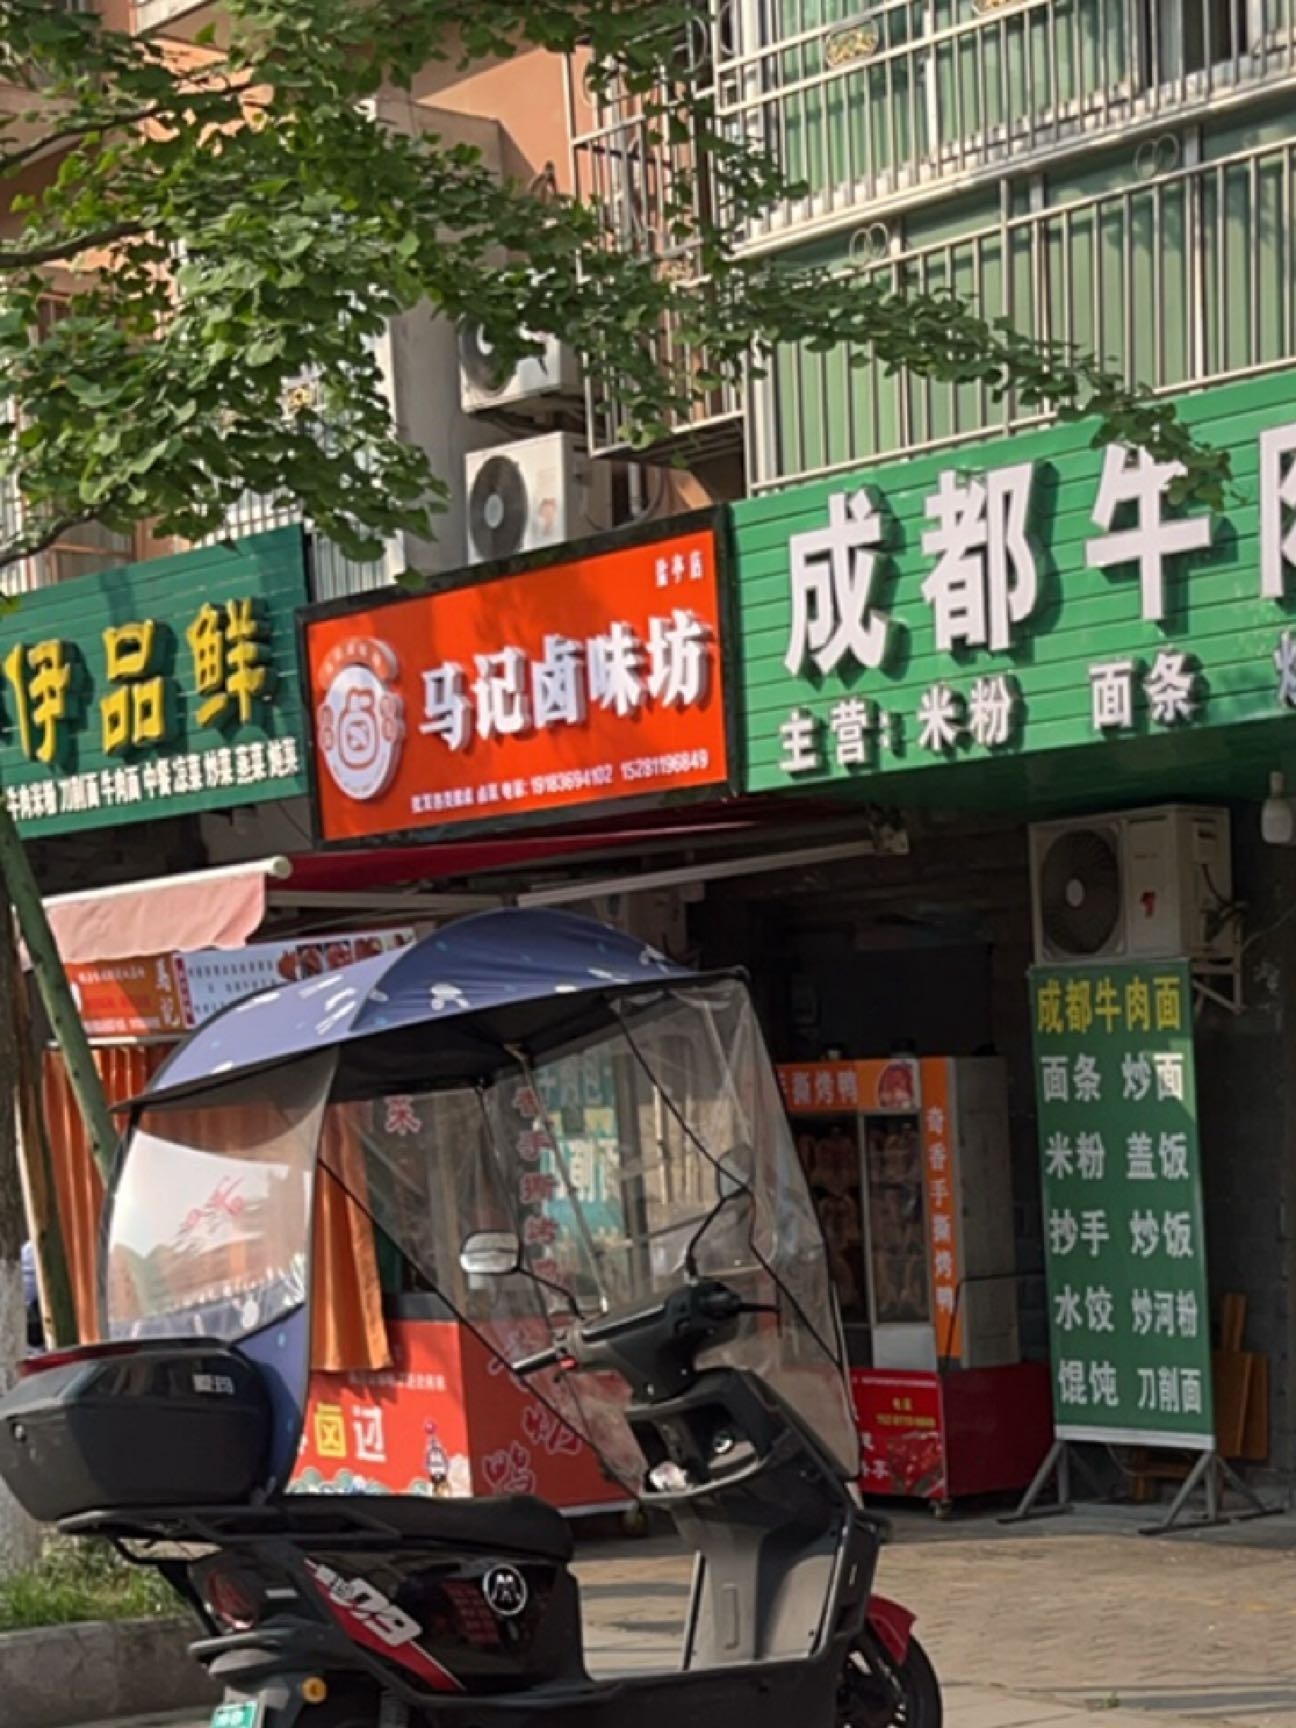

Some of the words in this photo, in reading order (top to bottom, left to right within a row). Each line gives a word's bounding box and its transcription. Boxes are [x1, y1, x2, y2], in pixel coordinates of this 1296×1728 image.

[3, 598, 268, 762] 伊品鲜
[419, 609, 704, 750] 马记卤味坊
[1089, 650, 1198, 730] 面条
[1037, 976, 1182, 1033] 成都牛肉面
[1041, 1053, 1101, 1102] 面条
[1121, 1051, 1184, 1101] 炒面
[1046, 1131, 1105, 1181] 米粉
[1126, 1131, 1190, 1181] 盖饭
[1049, 1208, 1110, 1257] 抄手
[1129, 1209, 1194, 1259] 炒饭
[1055, 1284, 1114, 1332] 水饺
[1131, 1288, 1198, 1338] 炒河粉
[1058, 1359, 1119, 1406] 馄饨
[1137, 1366, 1202, 1414] 刀削面
